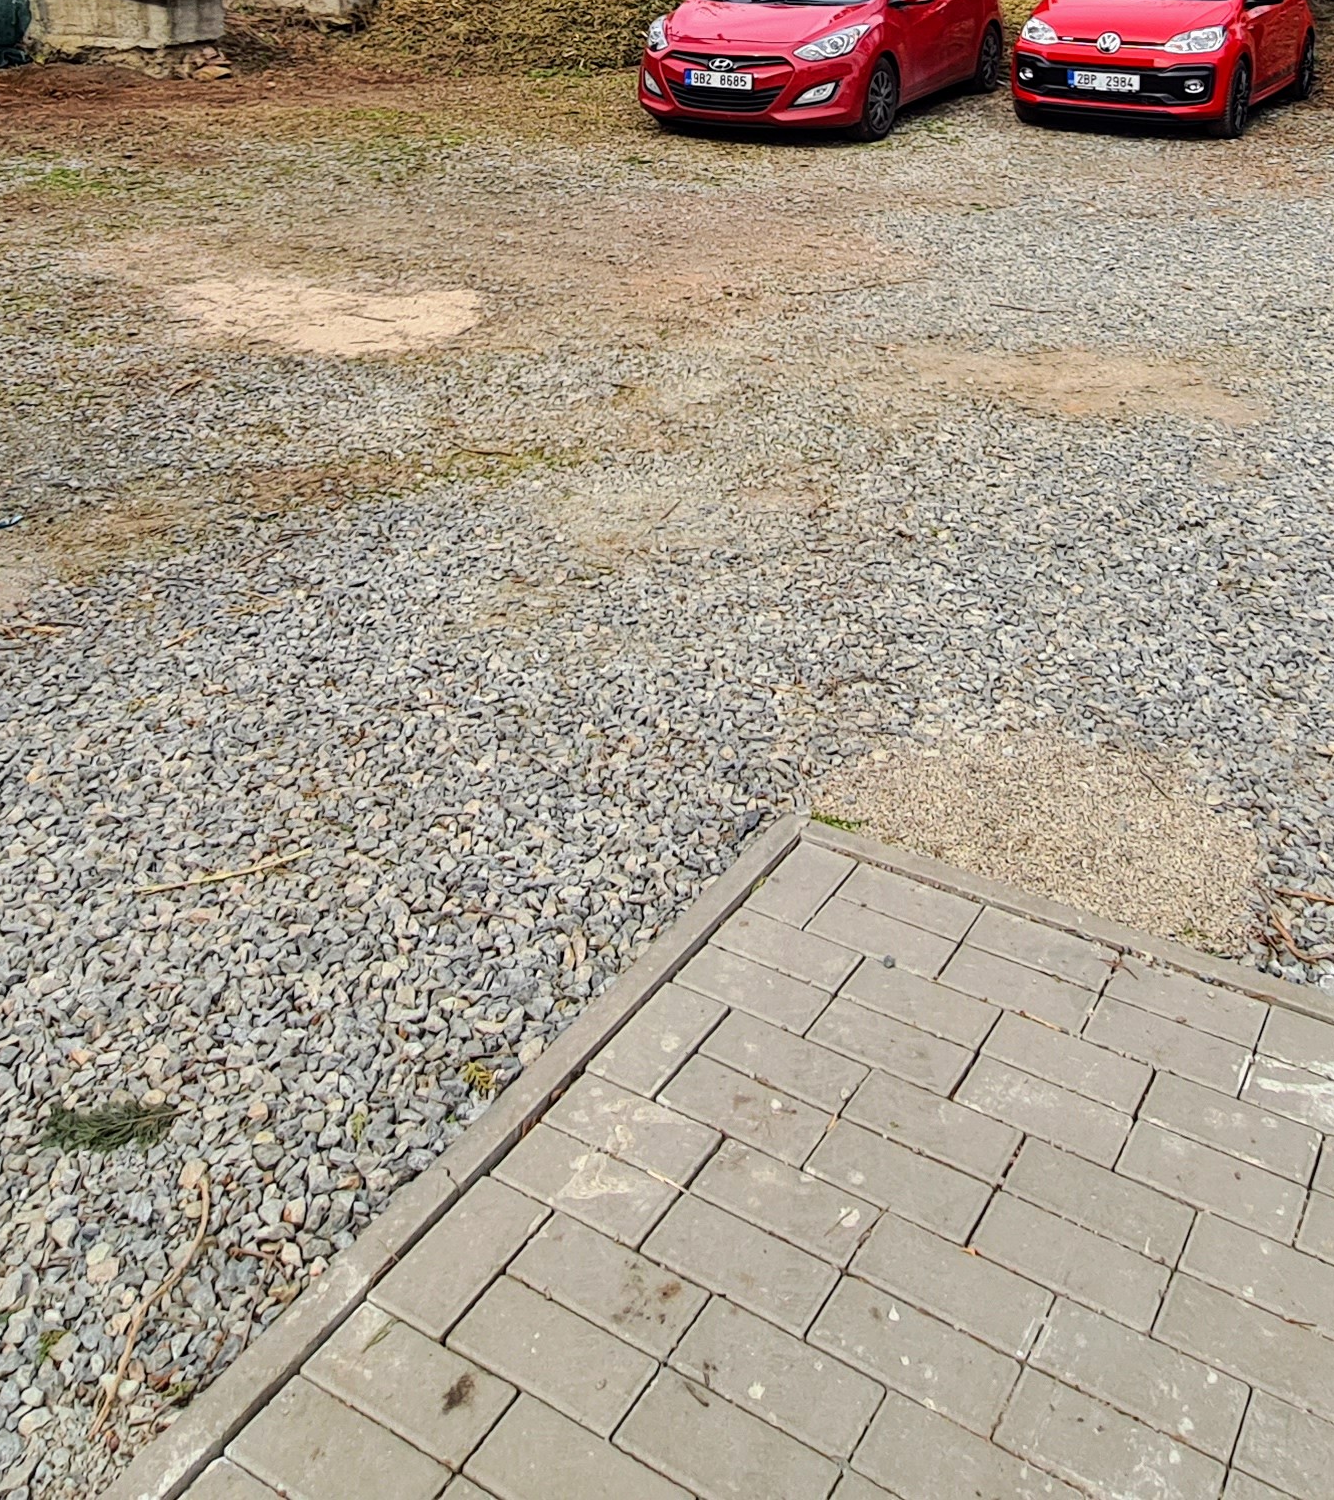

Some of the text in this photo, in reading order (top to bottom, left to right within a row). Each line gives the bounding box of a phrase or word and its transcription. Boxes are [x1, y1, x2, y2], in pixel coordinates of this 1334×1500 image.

[693, 72, 747, 87] 9B2 8685
[1077, 73, 1134, 88] 2BP 2984
